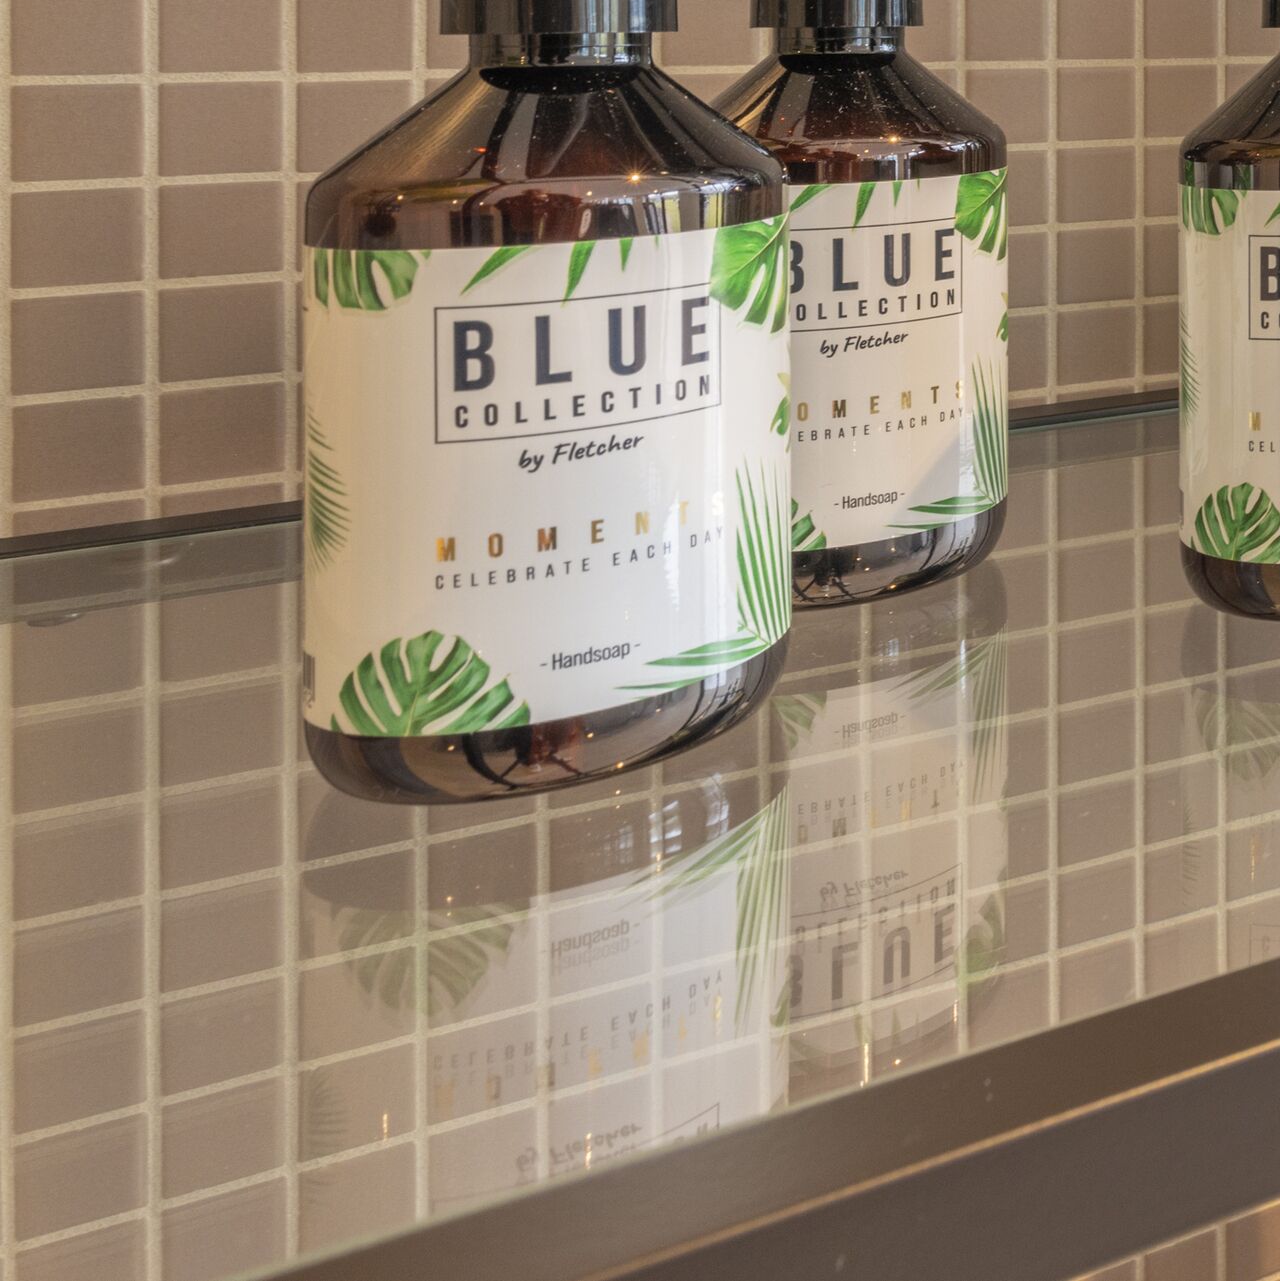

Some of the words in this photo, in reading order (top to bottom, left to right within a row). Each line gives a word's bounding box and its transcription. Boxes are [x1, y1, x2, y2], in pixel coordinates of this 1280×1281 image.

[795, 288, 955, 322] OLLECTION
[453, 296, 710, 392] BLUE
[819, 339, 838, 359] by
[843, 331, 909, 352] Fletcher
[454, 374, 710, 429] COLLECTION
[796, 380, 964, 422] OMENTS
[797, 424, 871, 442] EBRATE
[885, 416, 928, 433] EACH
[939, 407, 964, 423] DAY
[518, 449, 544, 473] by
[551, 433, 645, 465] Fletcher
[436, 491, 725, 562] MOMENTS
[435, 557, 591, 590] CELEBRATE
[612, 541, 672, 567] EACH
[690, 526, 725, 548] DAY
